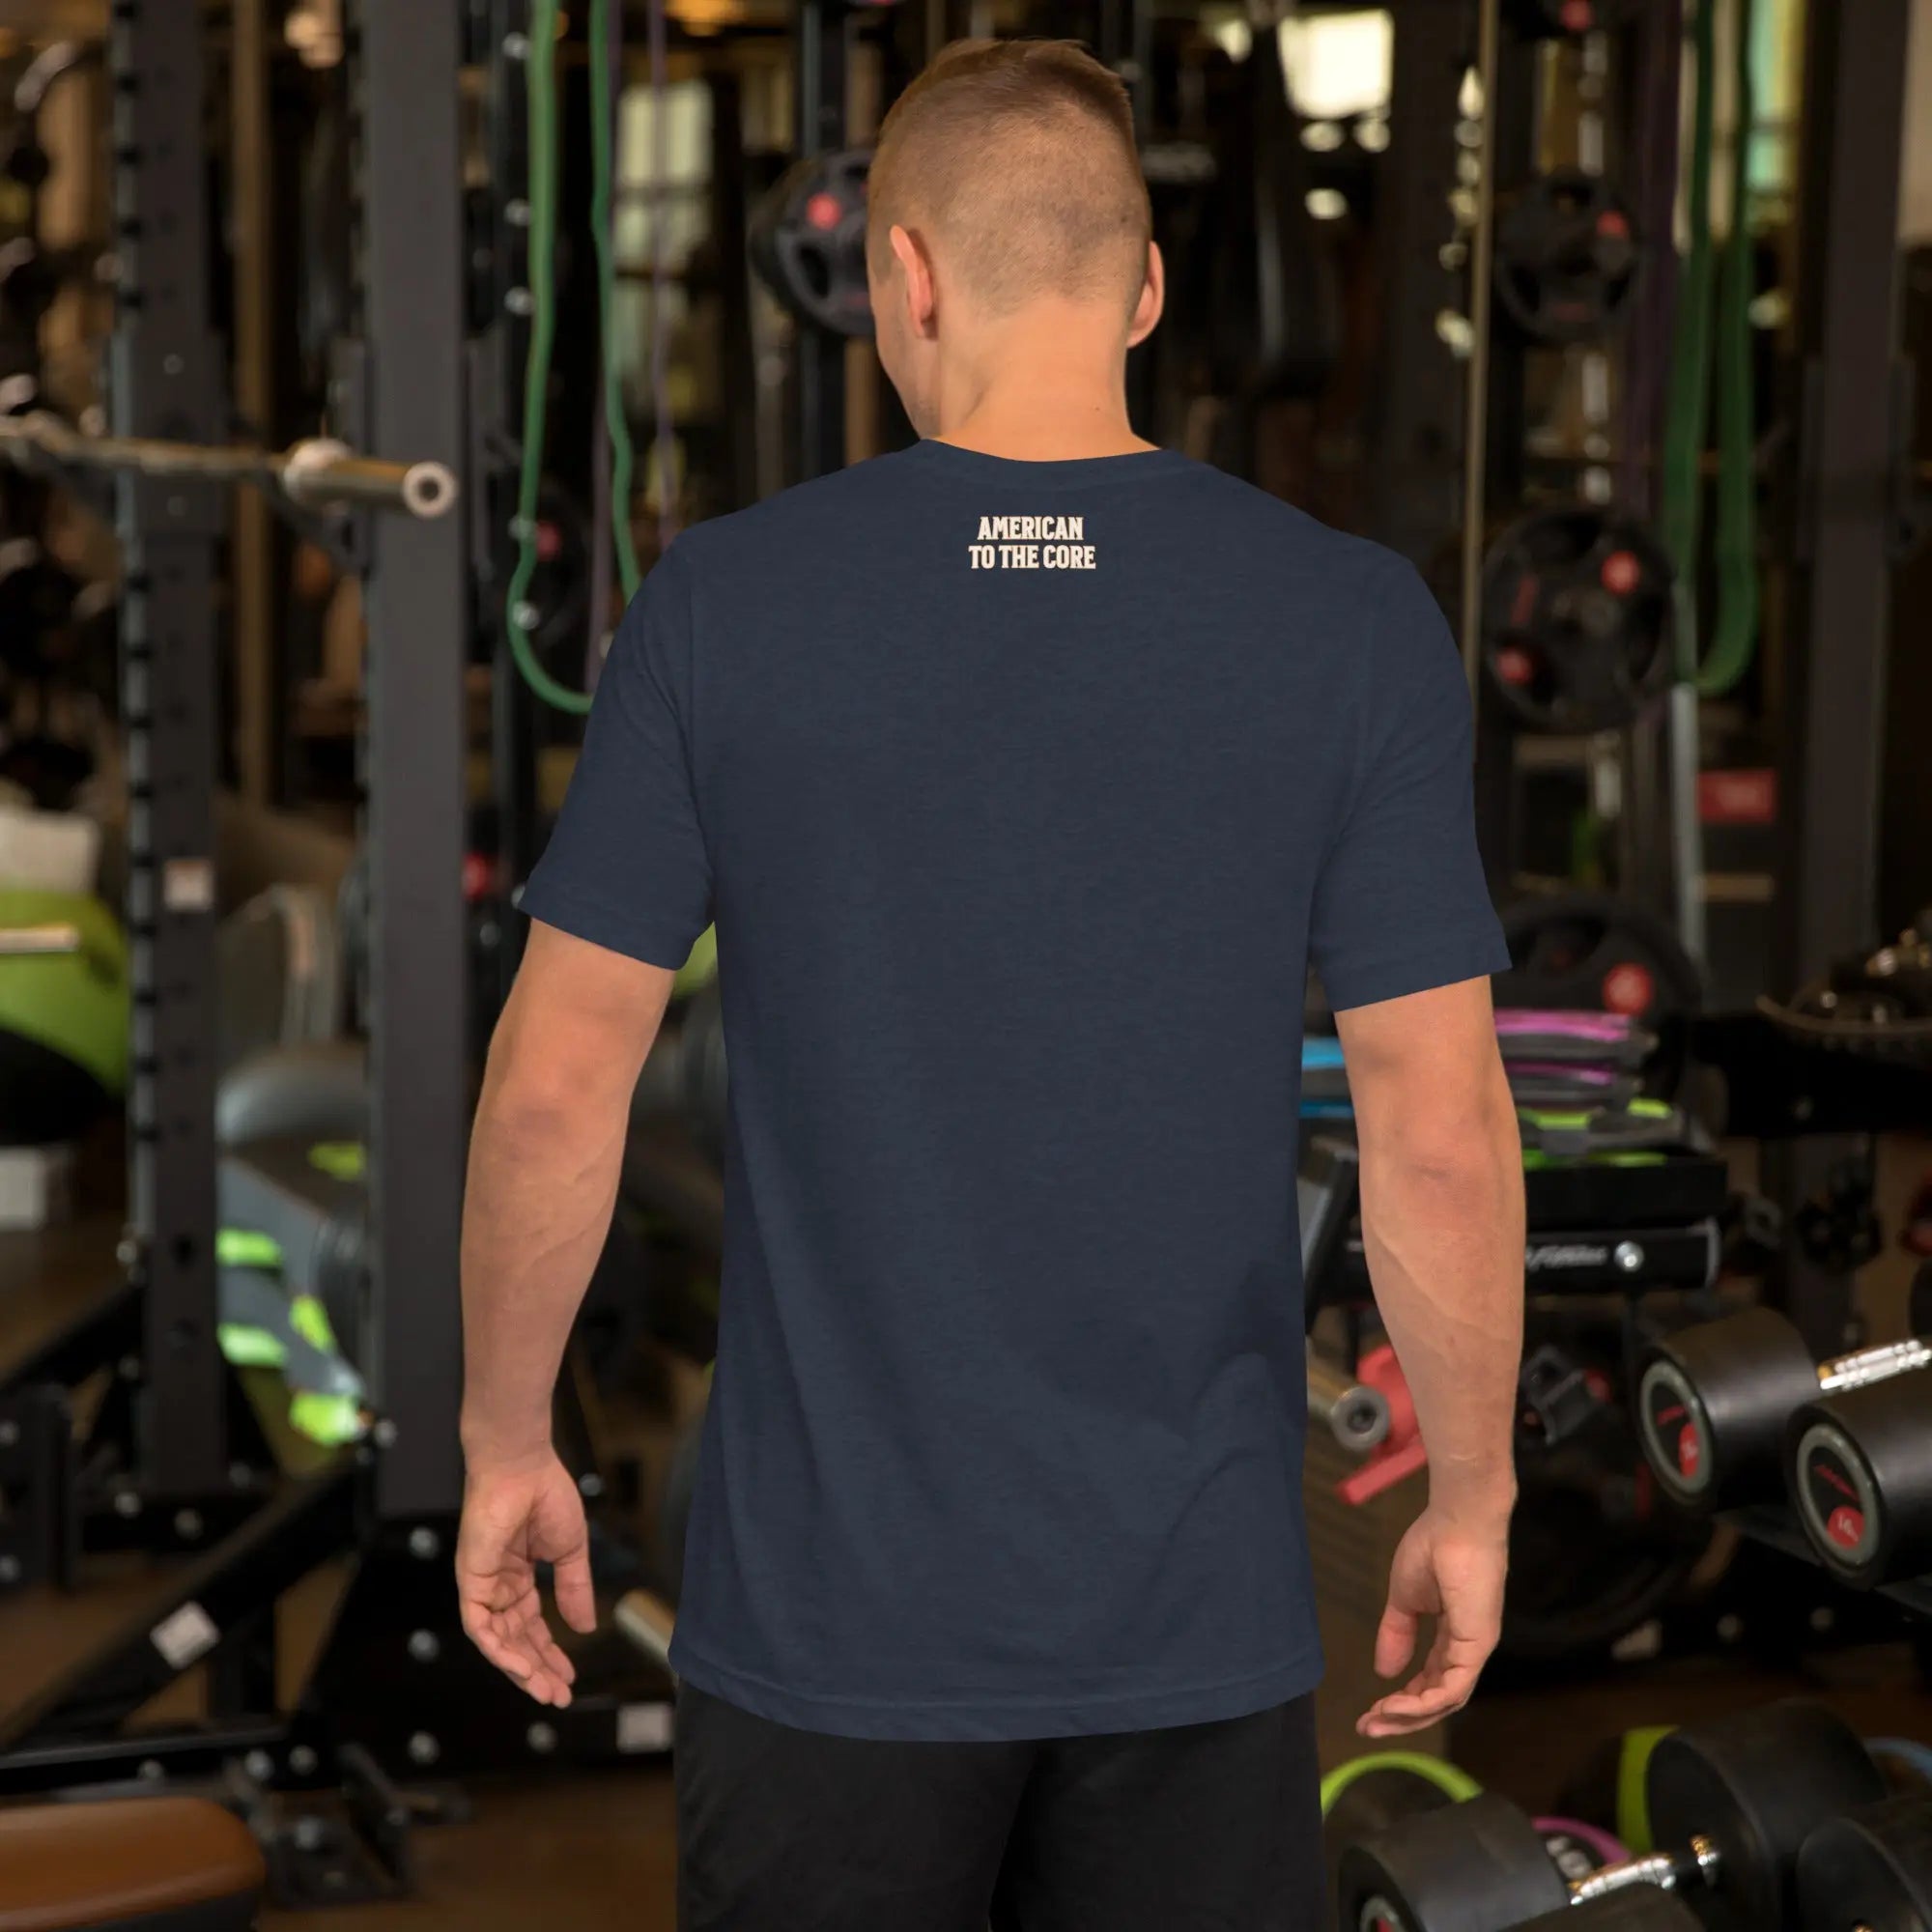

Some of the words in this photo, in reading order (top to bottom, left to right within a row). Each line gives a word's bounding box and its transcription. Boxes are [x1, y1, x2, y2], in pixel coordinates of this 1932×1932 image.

[977, 516, 1084, 540] AMERICAN
[968, 545, 995, 569] TO
[998, 545, 1039, 569] THE
[1043, 545, 1096, 569] CORE
